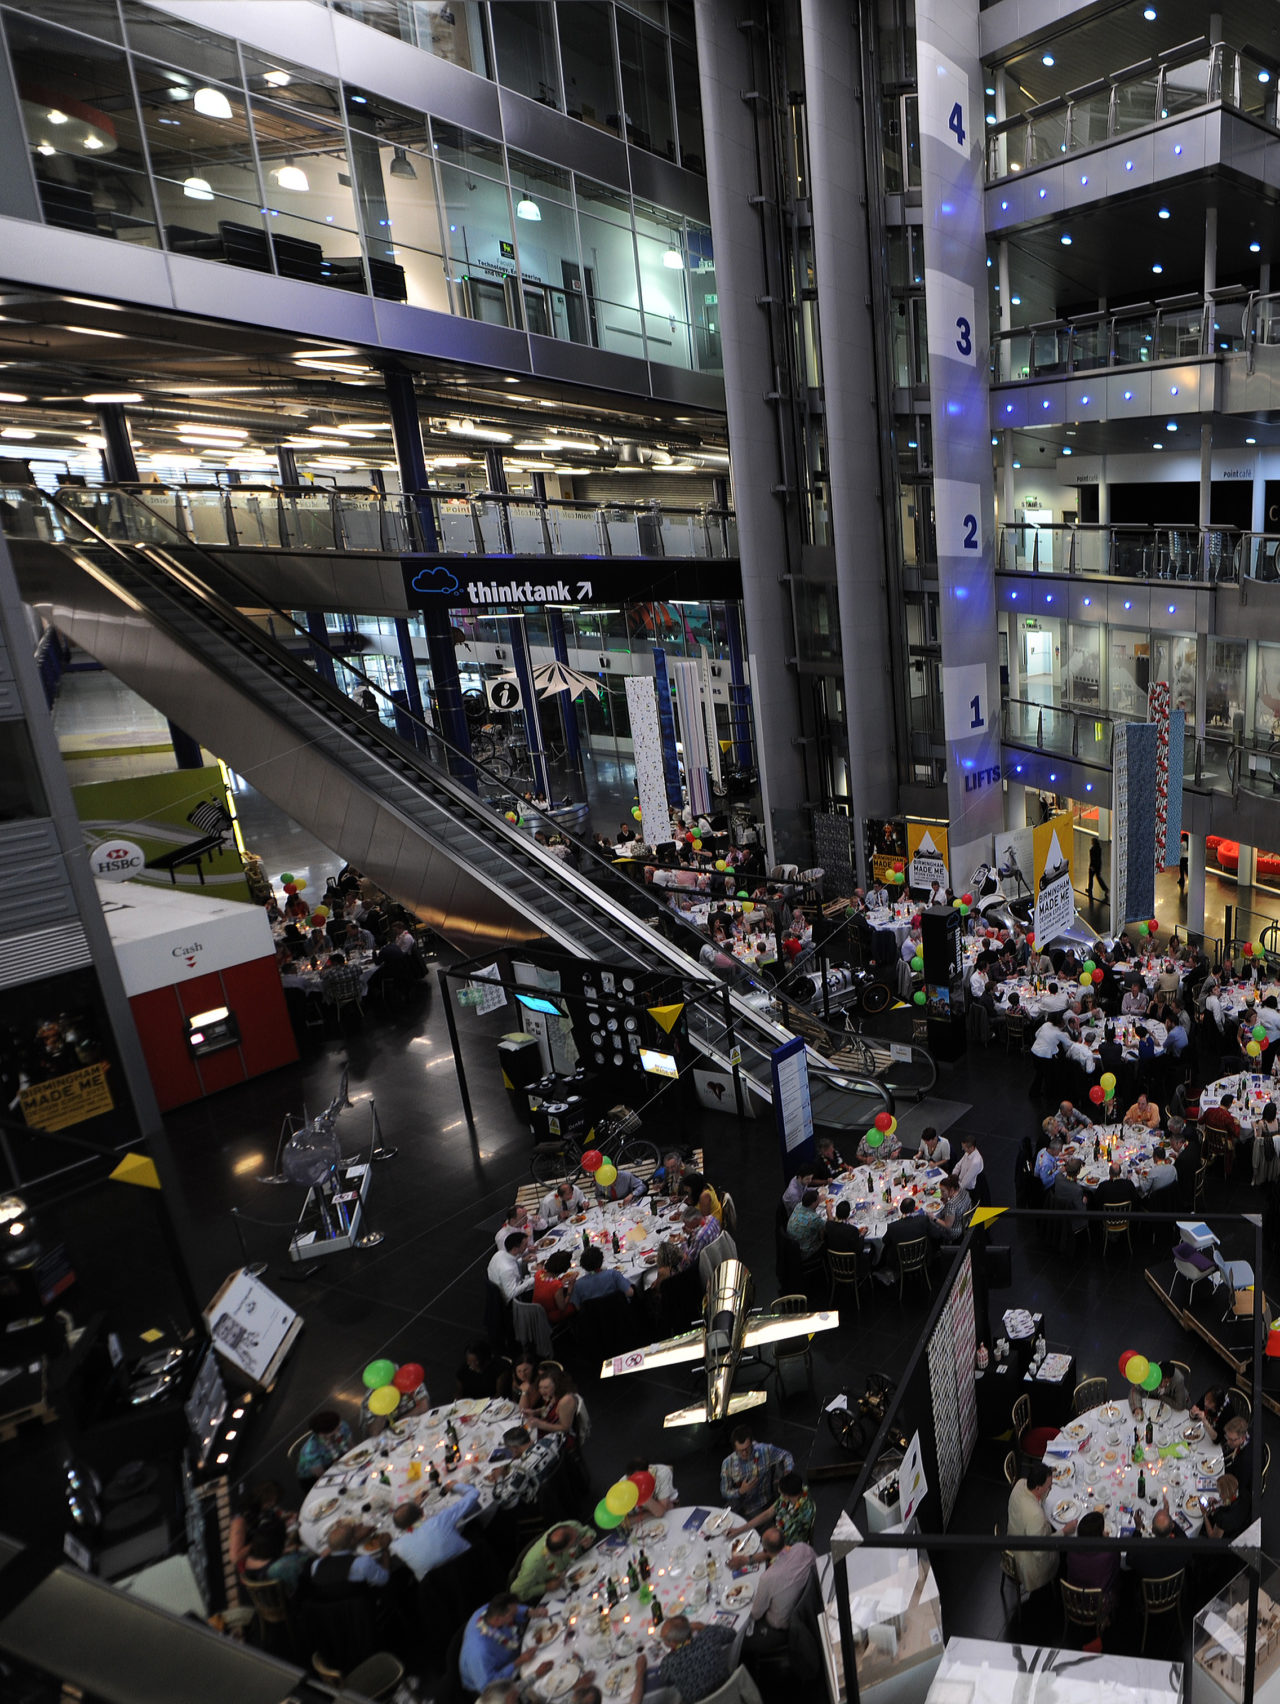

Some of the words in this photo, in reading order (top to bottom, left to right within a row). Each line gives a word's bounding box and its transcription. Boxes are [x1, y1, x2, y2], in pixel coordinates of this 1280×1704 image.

[948, 102, 966, 146] 4
[956, 316, 972, 356] 3
[963, 514, 978, 549] 2
[468, 581, 570, 604] thinktank
[970, 695, 984, 729] 1
[965, 764, 1001, 793] LIFTS
[98, 856, 141, 873] HSBC
[913, 865, 932, 873] MADE
[1039, 895, 1059, 916] MADE
[171, 943, 203, 957] Cash
[24, 1085, 74, 1110] MADE
[79, 1074, 103, 1091] ME
